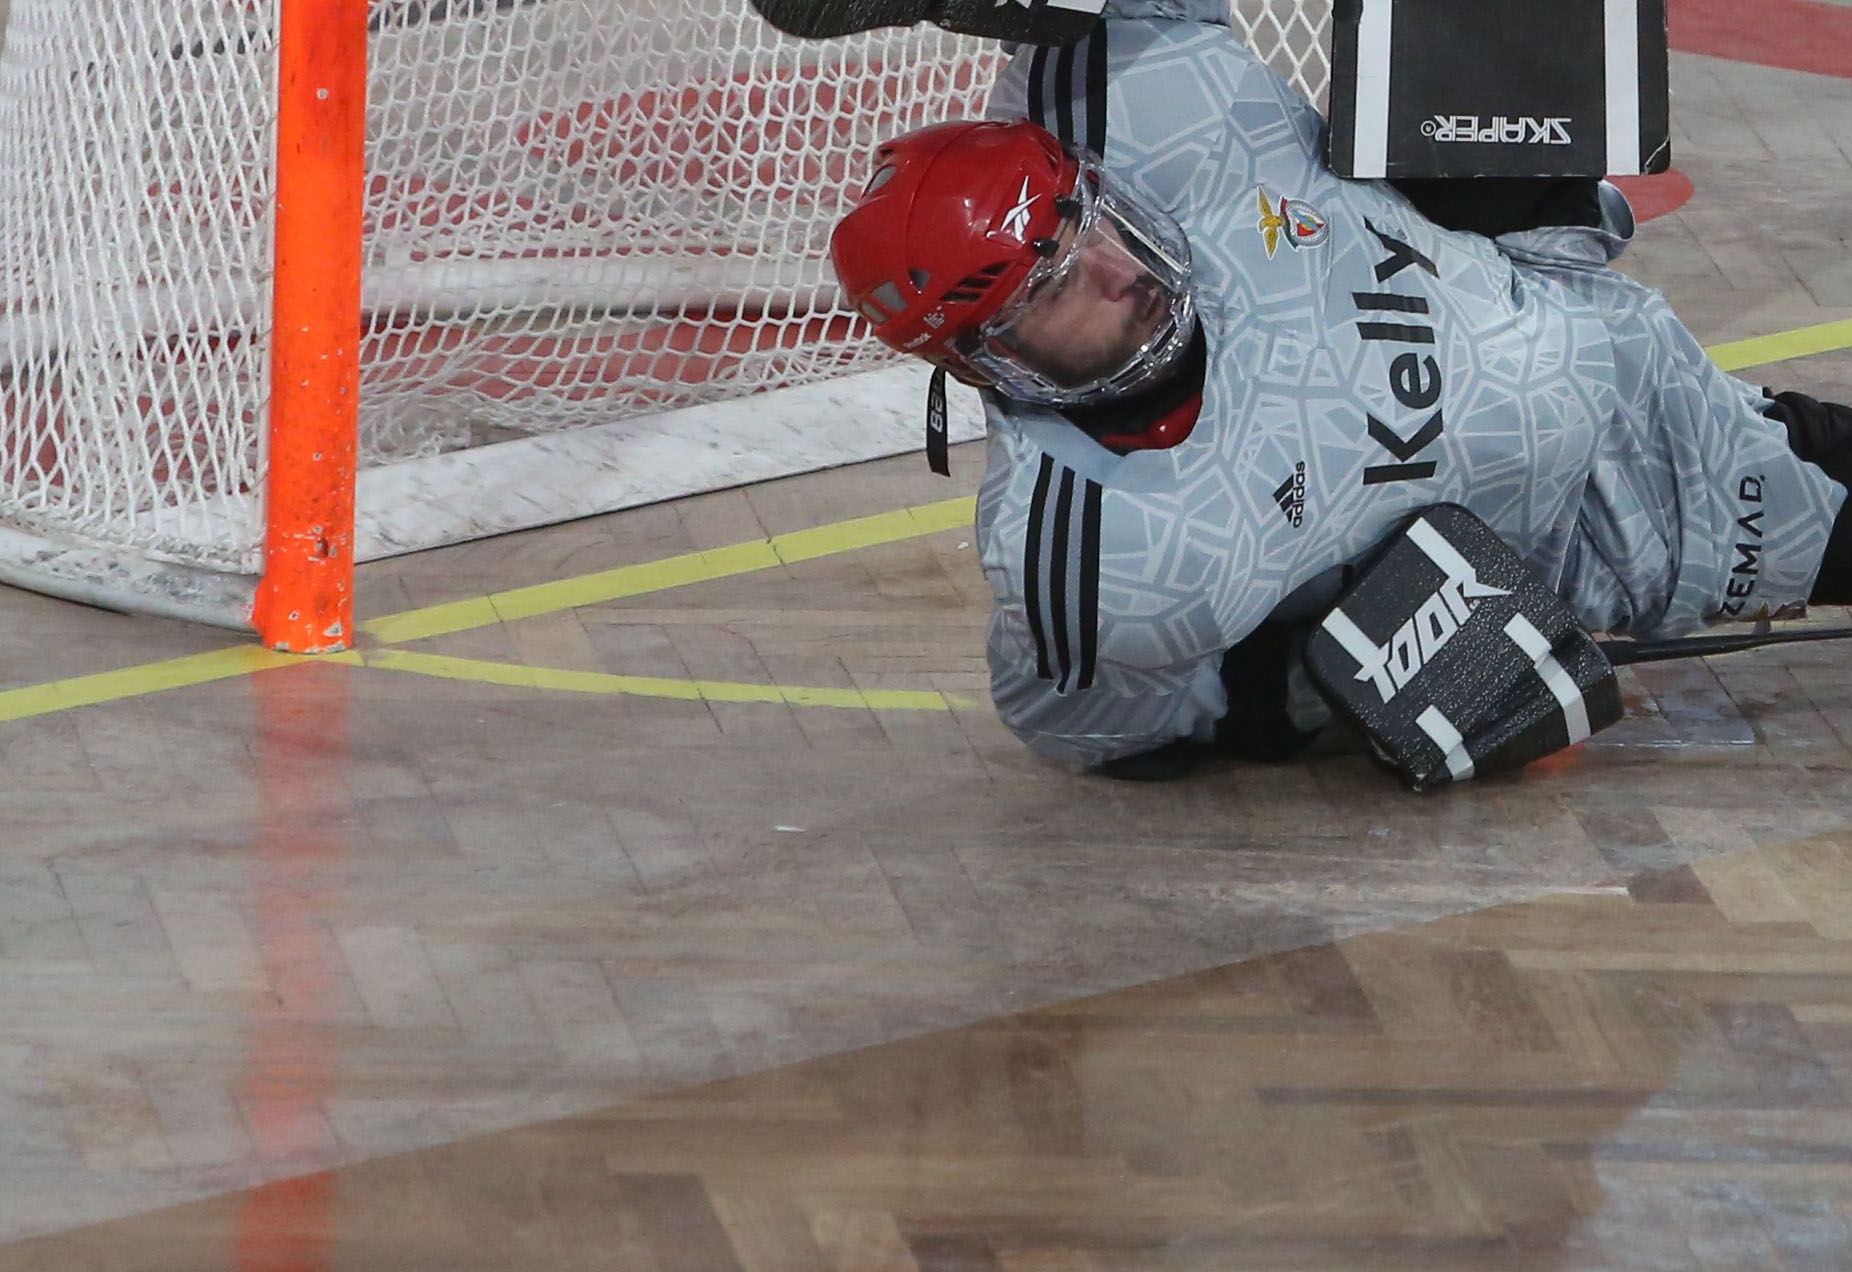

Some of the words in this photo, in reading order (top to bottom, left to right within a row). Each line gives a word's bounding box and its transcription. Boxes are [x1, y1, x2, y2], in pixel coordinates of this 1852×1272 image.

[1434, 114, 1572, 145] SKAPER
[1351, 216, 1444, 486] Kelly
[1292, 461, 1305, 529] adidas
